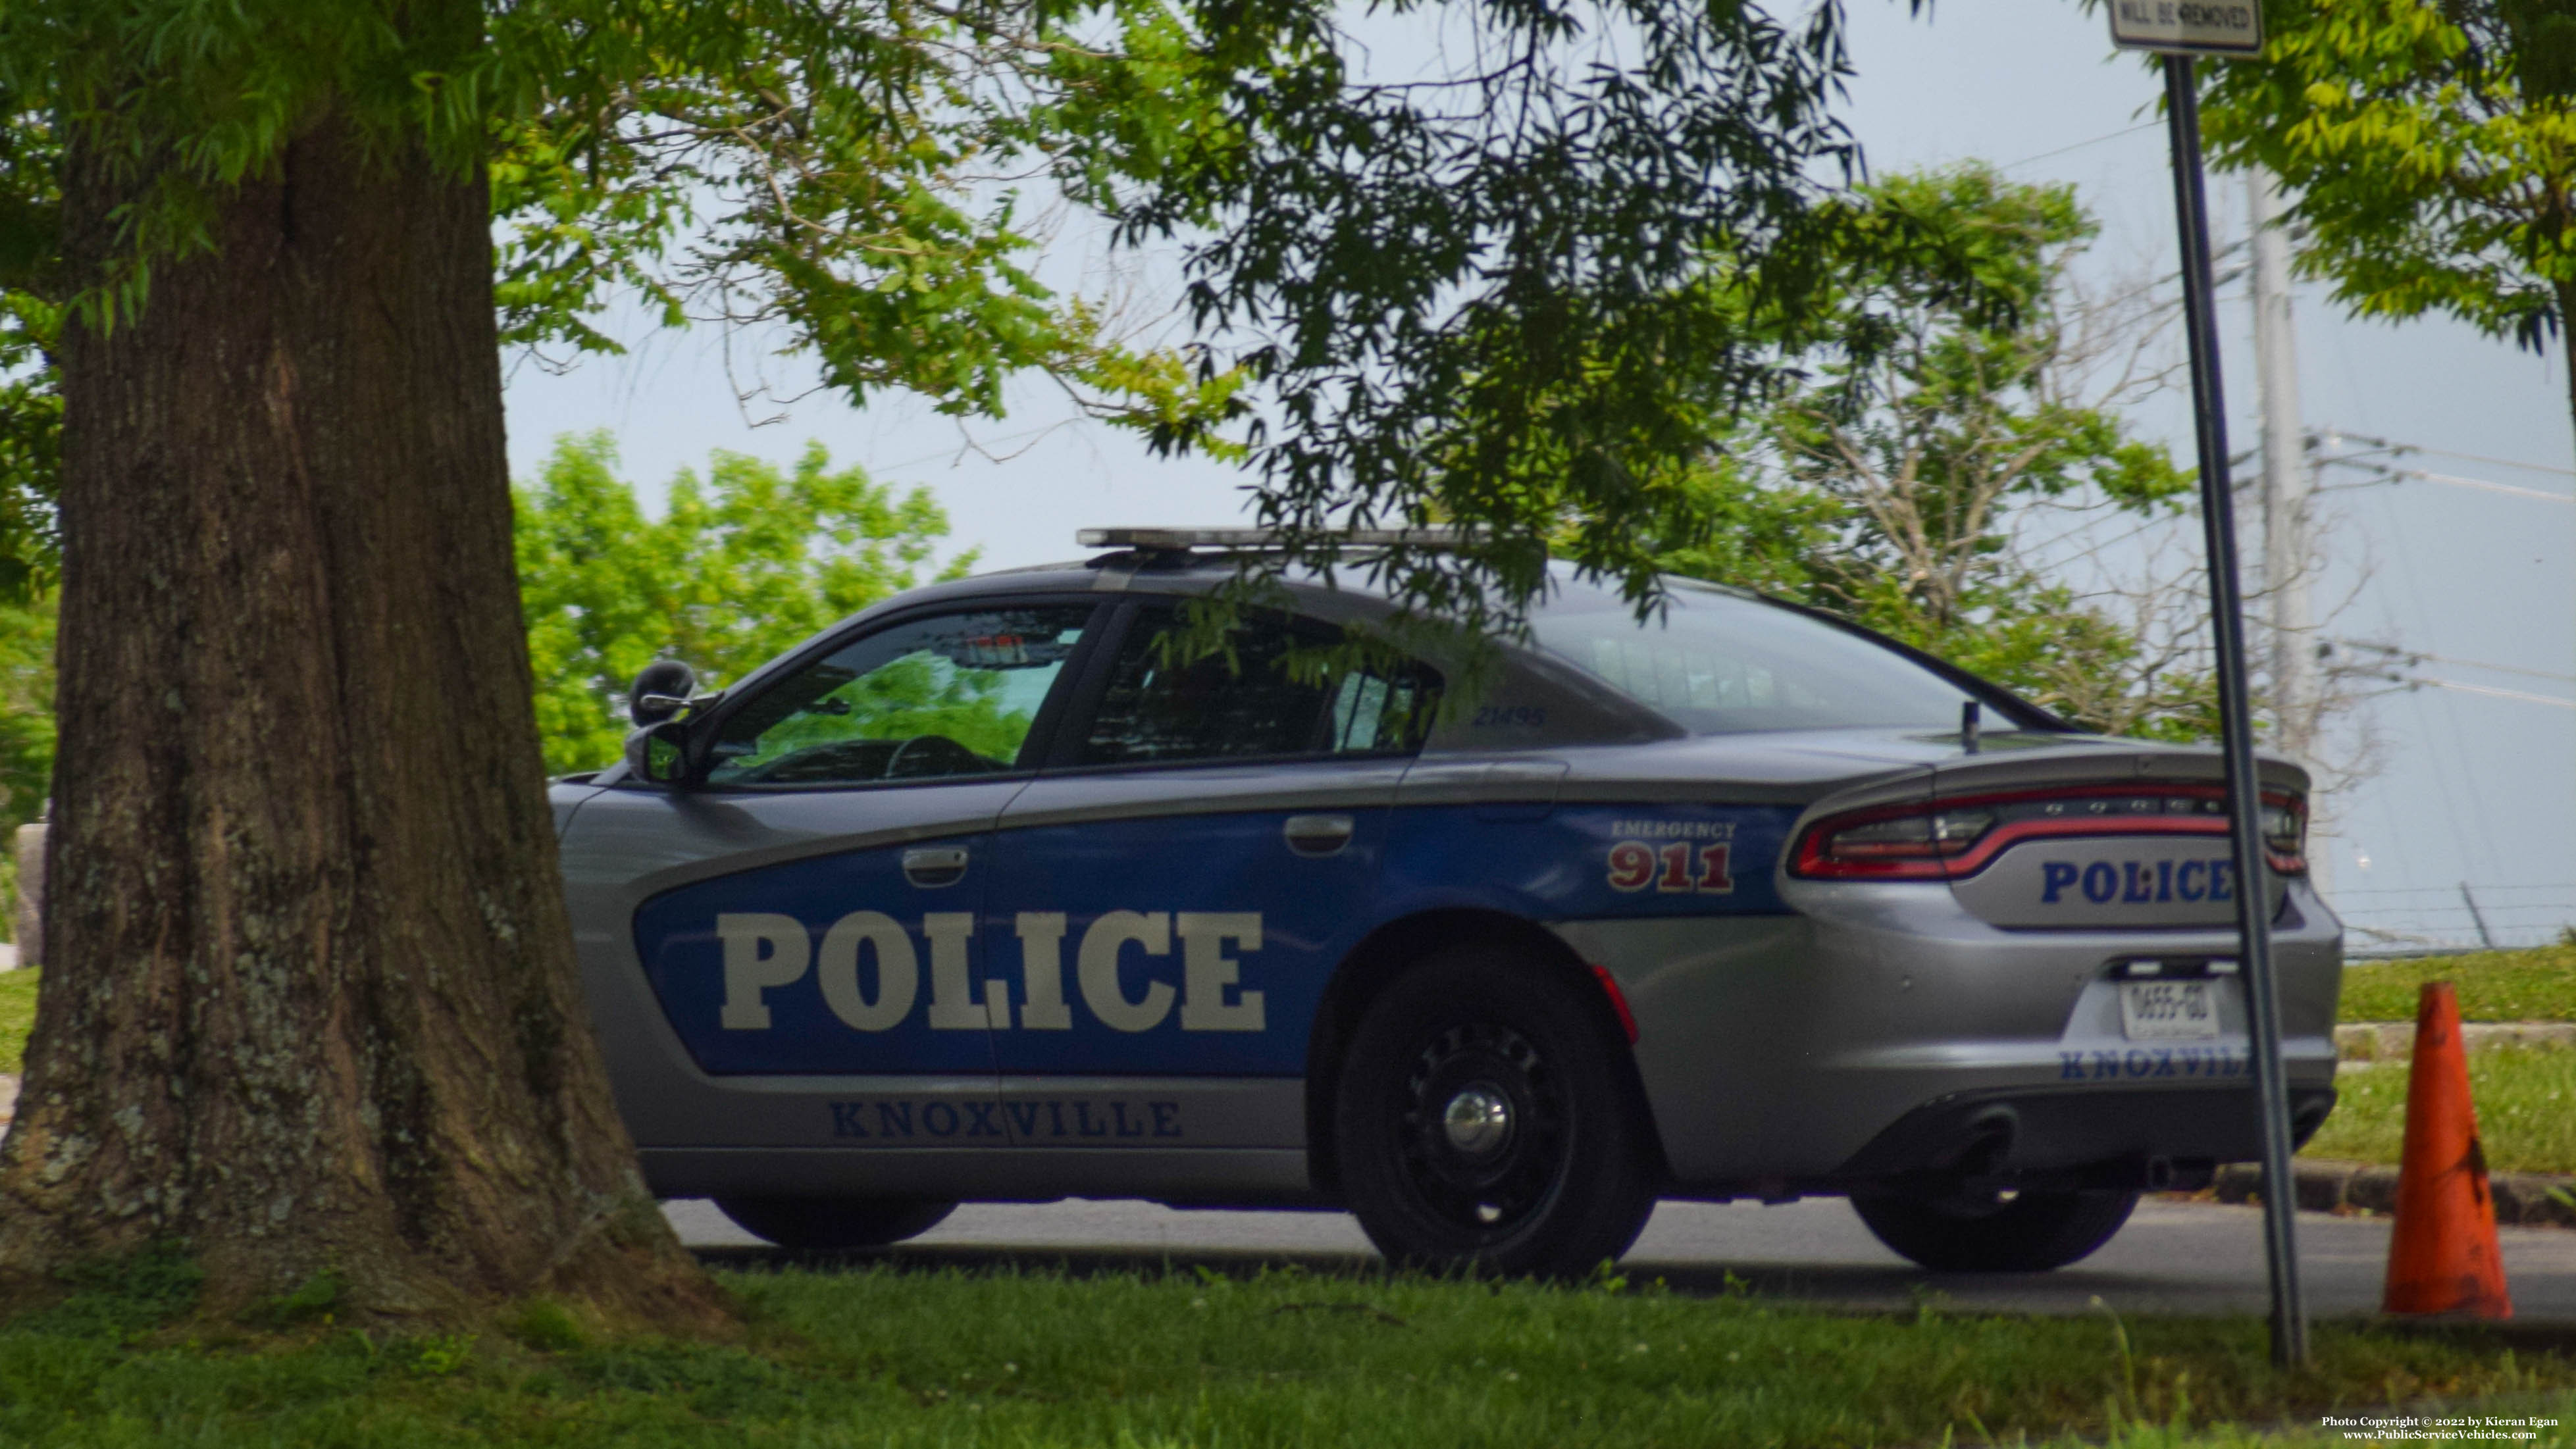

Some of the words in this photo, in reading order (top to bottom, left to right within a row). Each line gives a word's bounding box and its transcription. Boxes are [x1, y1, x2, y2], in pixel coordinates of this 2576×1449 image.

[2120, 1, 2151, 24] WILL
[2157, 3, 2175, 26] BE
[2178, 4, 2250, 30] REMOVED
[1611, 821, 1737, 839] EMERGENCY
[1607, 840, 1735, 894] 911
[2042, 860, 2234, 903] POLICE
[717, 910, 1267, 1032] POLICE
[831, 1102, 1183, 1138] KNOXVILLE
